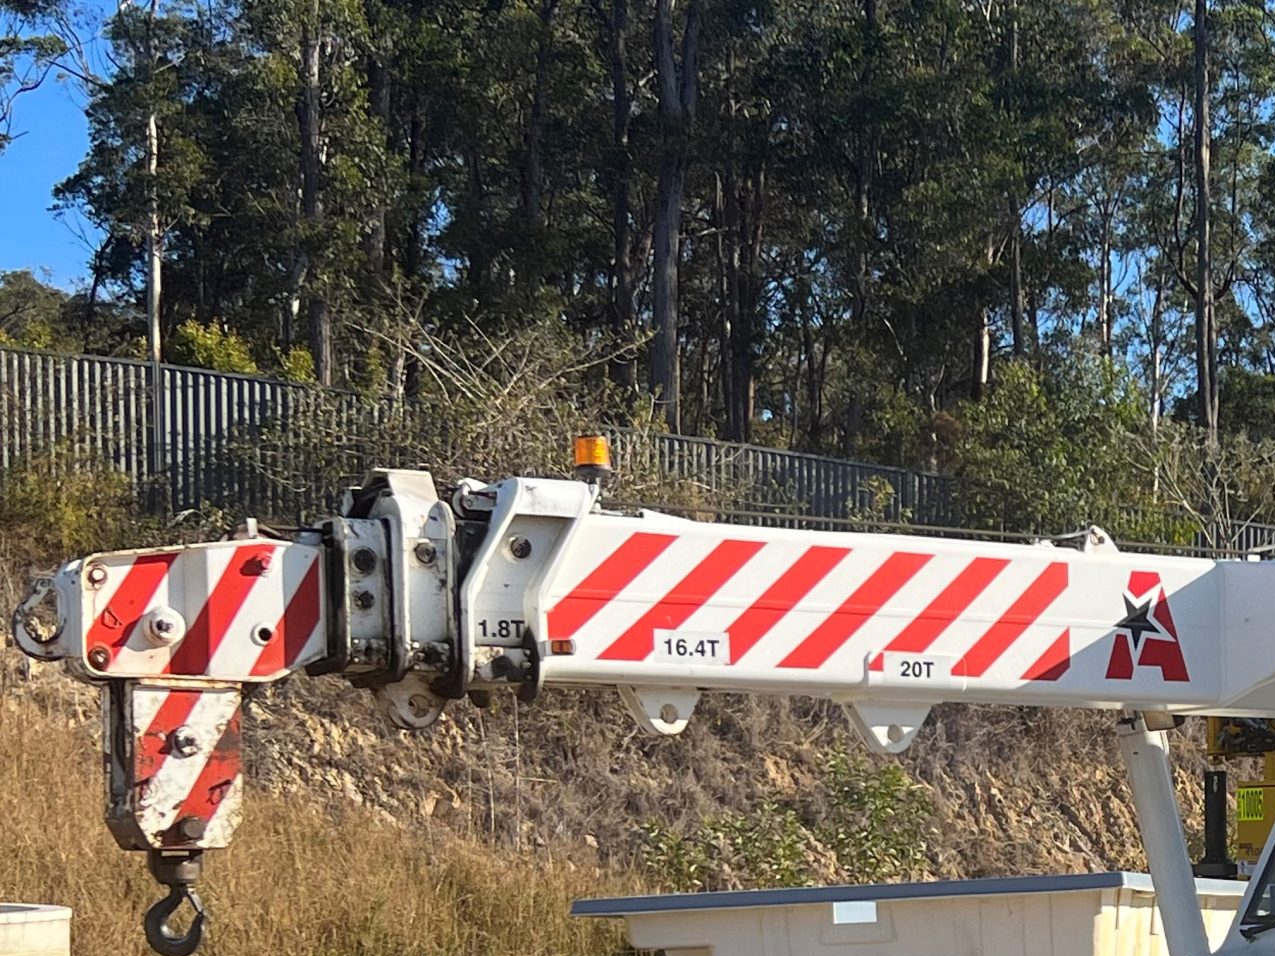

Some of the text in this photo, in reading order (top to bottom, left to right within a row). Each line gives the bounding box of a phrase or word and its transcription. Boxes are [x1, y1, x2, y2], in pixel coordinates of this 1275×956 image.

[478, 619, 525, 638] 1.8T
[664, 639, 720, 657] 16.4T
[900, 661, 935, 678] 20T
